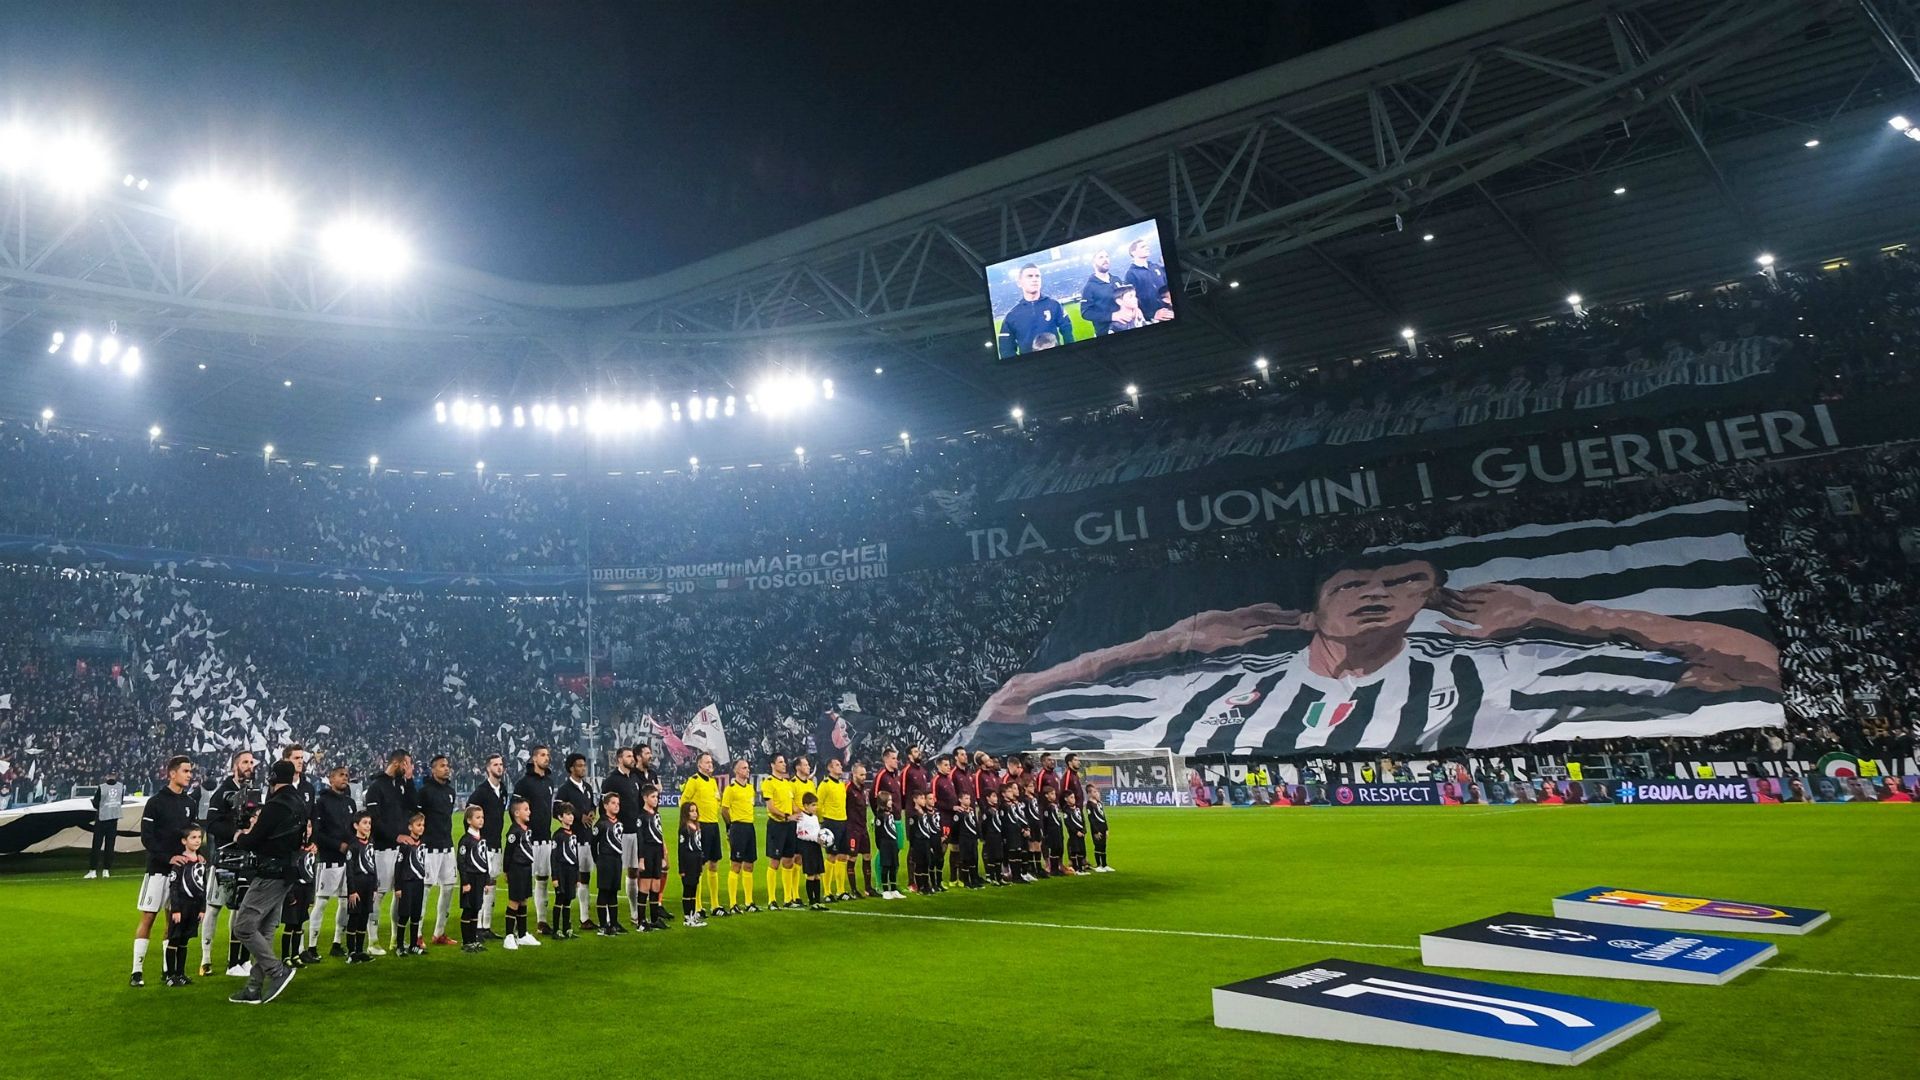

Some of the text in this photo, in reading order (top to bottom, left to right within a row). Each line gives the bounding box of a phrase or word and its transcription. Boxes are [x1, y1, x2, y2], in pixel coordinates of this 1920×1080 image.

[965, 403, 1840, 560] TRA GLI UOMINI I GUERRIERI
[666, 581, 695, 593] SUD
[1358, 787, 1431, 802] RESPECT
[1616, 781, 1748, 803] #EQUAL GAME
